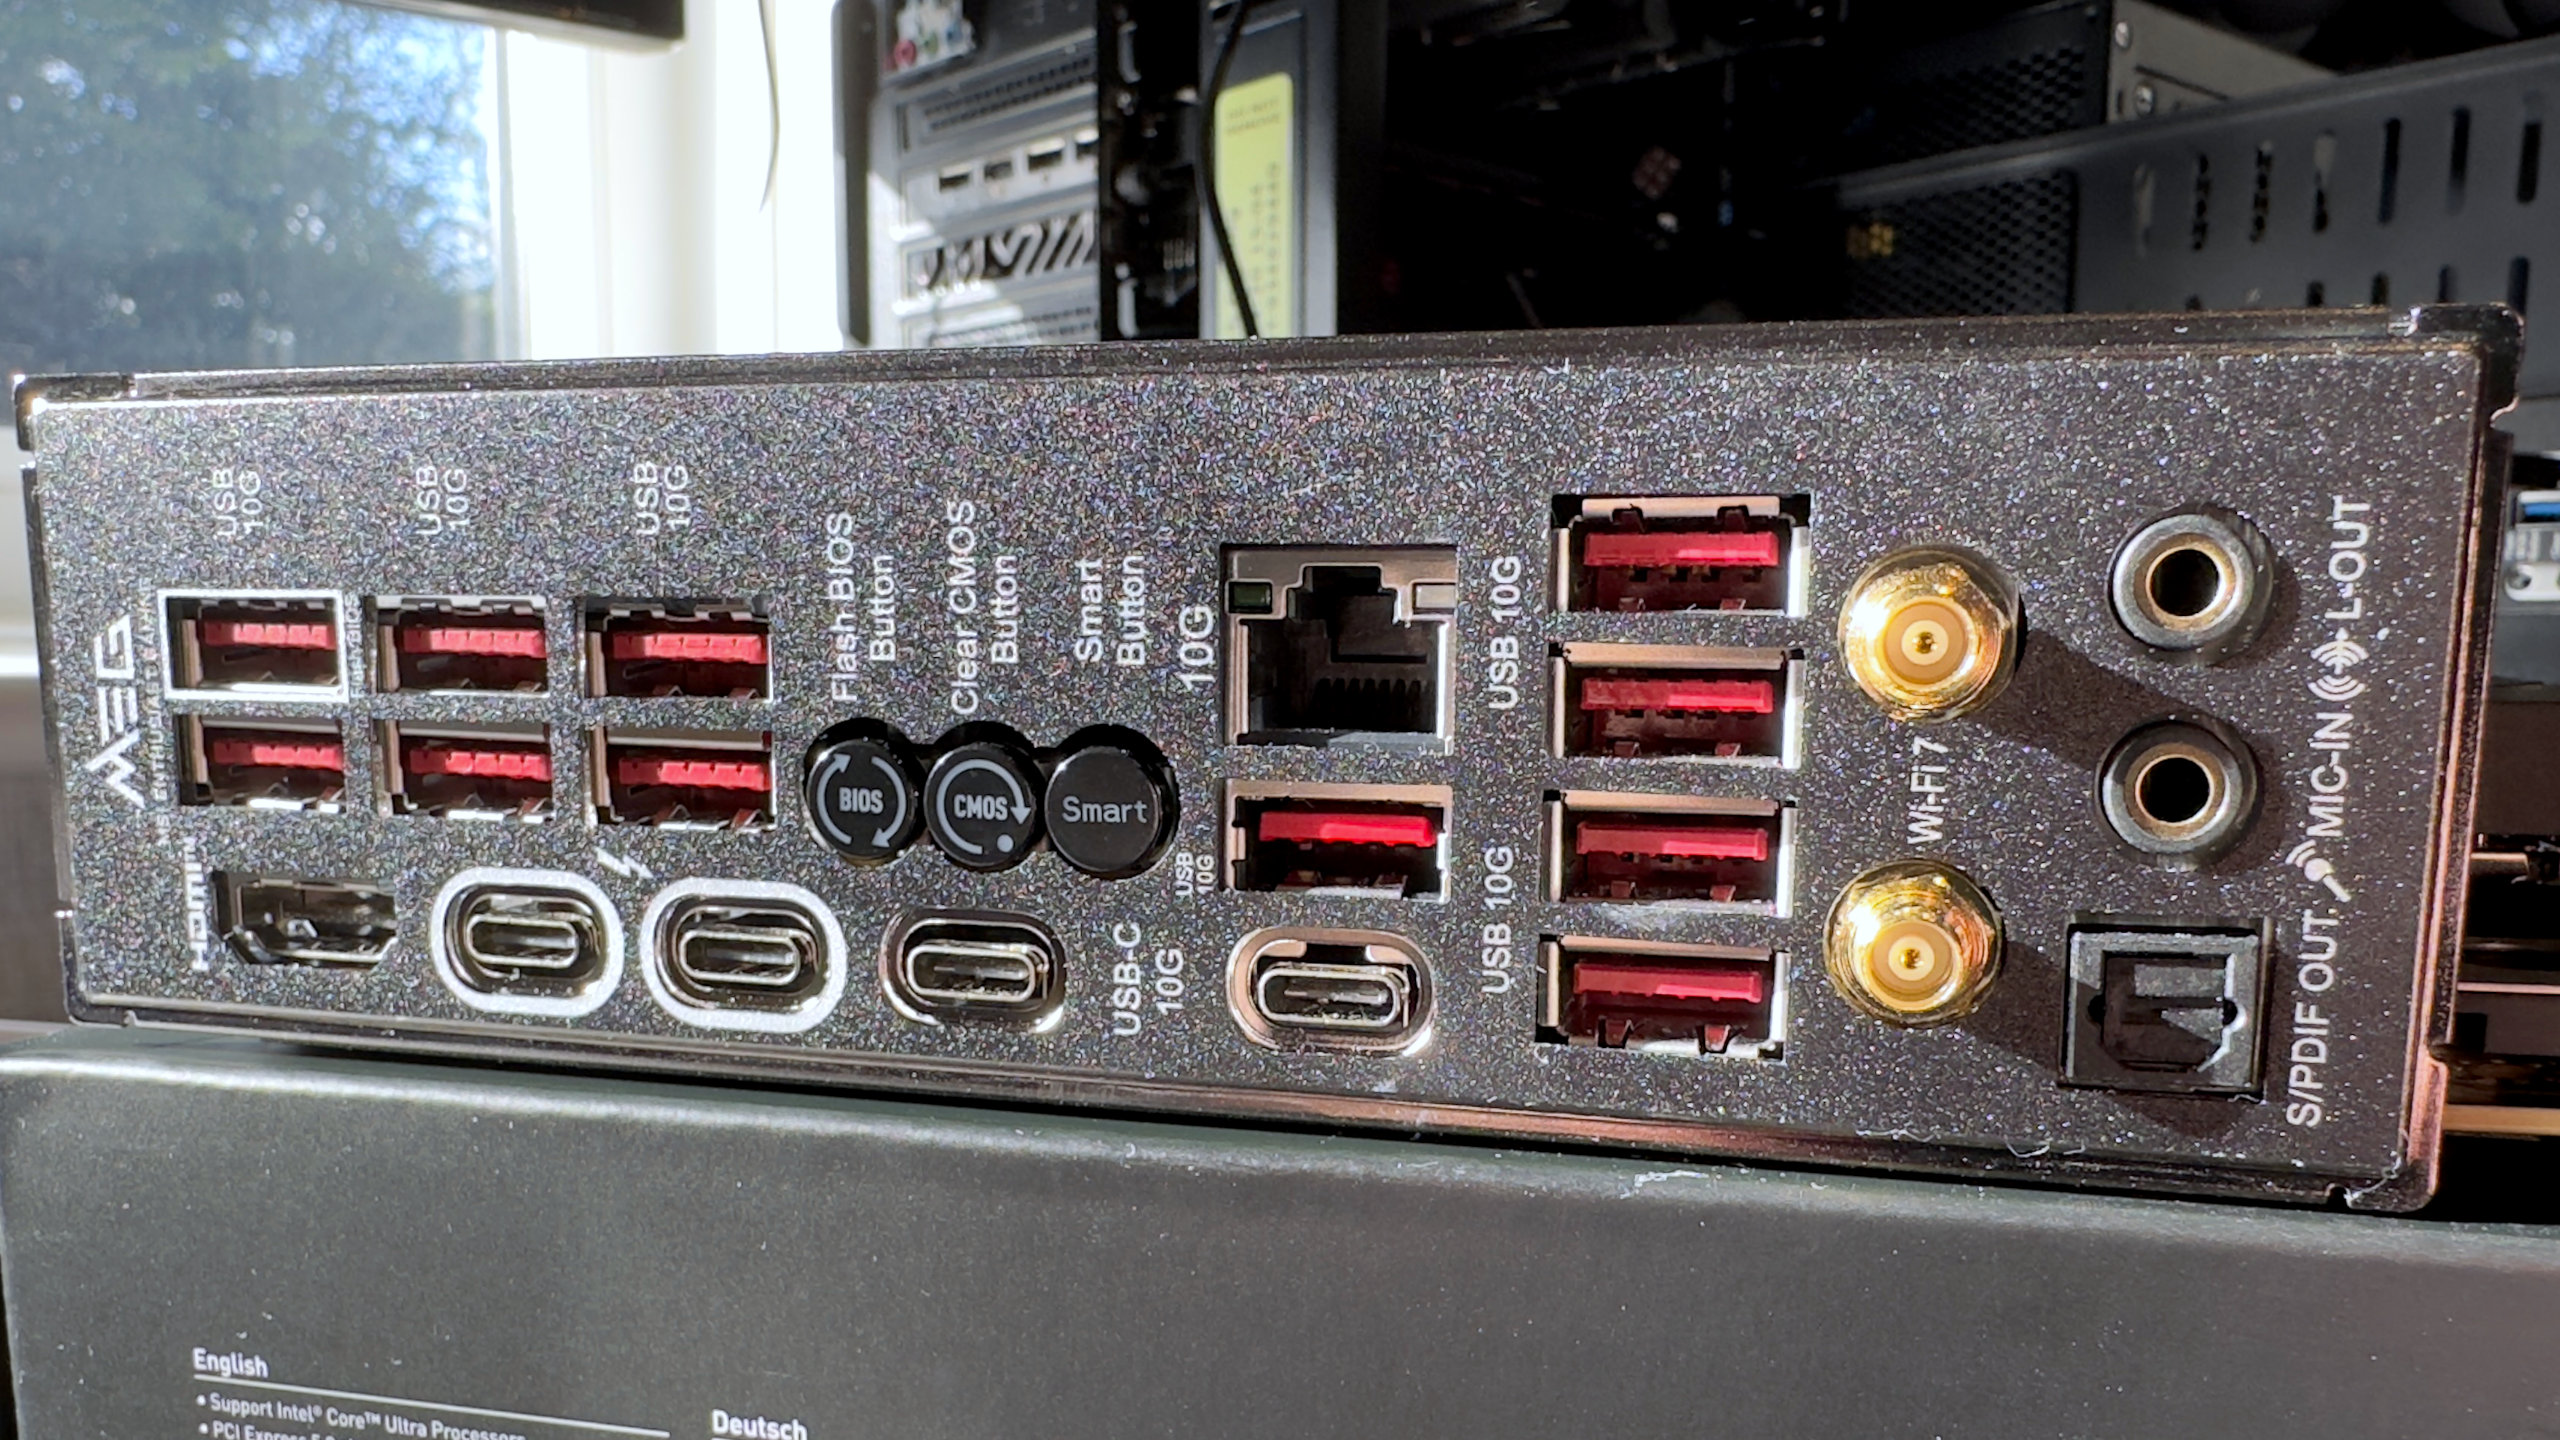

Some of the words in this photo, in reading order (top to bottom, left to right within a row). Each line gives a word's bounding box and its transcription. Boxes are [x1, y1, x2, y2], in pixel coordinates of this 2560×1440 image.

[213, 468, 238, 536] USB
[239, 470, 264, 535] 10G
[416, 465, 442, 536] USB
[445, 467, 470, 532] 10G
[633, 460, 661, 536] USB
[664, 464, 692, 532] 10G
[826, 511, 855, 601] BIOS
[946, 497, 977, 616] CMOS
[1490, 556, 1522, 624] 10G
[2324, 495, 2371, 620] L-OUT
[869, 553, 896, 662] Button
[991, 554, 1019, 665] Button
[1074, 557, 1103, 663] Smart
[1116, 554, 1146, 666] Button
[830, 612, 858, 702] Flash
[951, 623, 980, 716] Clear
[1174, 603, 1217, 691] 10G
[1488, 635, 1519, 710] USB
[1912, 735, 1949, 756] 7
[2305, 711, 2354, 838] MIC-IN
[838, 786, 884, 815] BIOS
[953, 793, 1009, 822] CMOS
[1061, 795, 1148, 825] Smart
[1906, 765, 1948, 845] Wi-Fi
[1176, 851, 1194, 897] USB
[1196, 853, 1215, 896] 10G
[1484, 846, 1514, 911] 10G
[1112, 922, 1142, 1037] USB-C
[1155, 949, 1185, 1016] 10G
[1481, 922, 1512, 994] USB
[2298, 908, 2340, 993] OUT
[2286, 1002, 2331, 1128] S/PDIF
[192, 1347, 270, 1379] English
[210, 1392, 274, 1418] Support
[384, 1414, 428, 1438] Ultra
[212, 1420, 240, 1440] PCI
[711, 1408, 808, 1440] Deutsch
